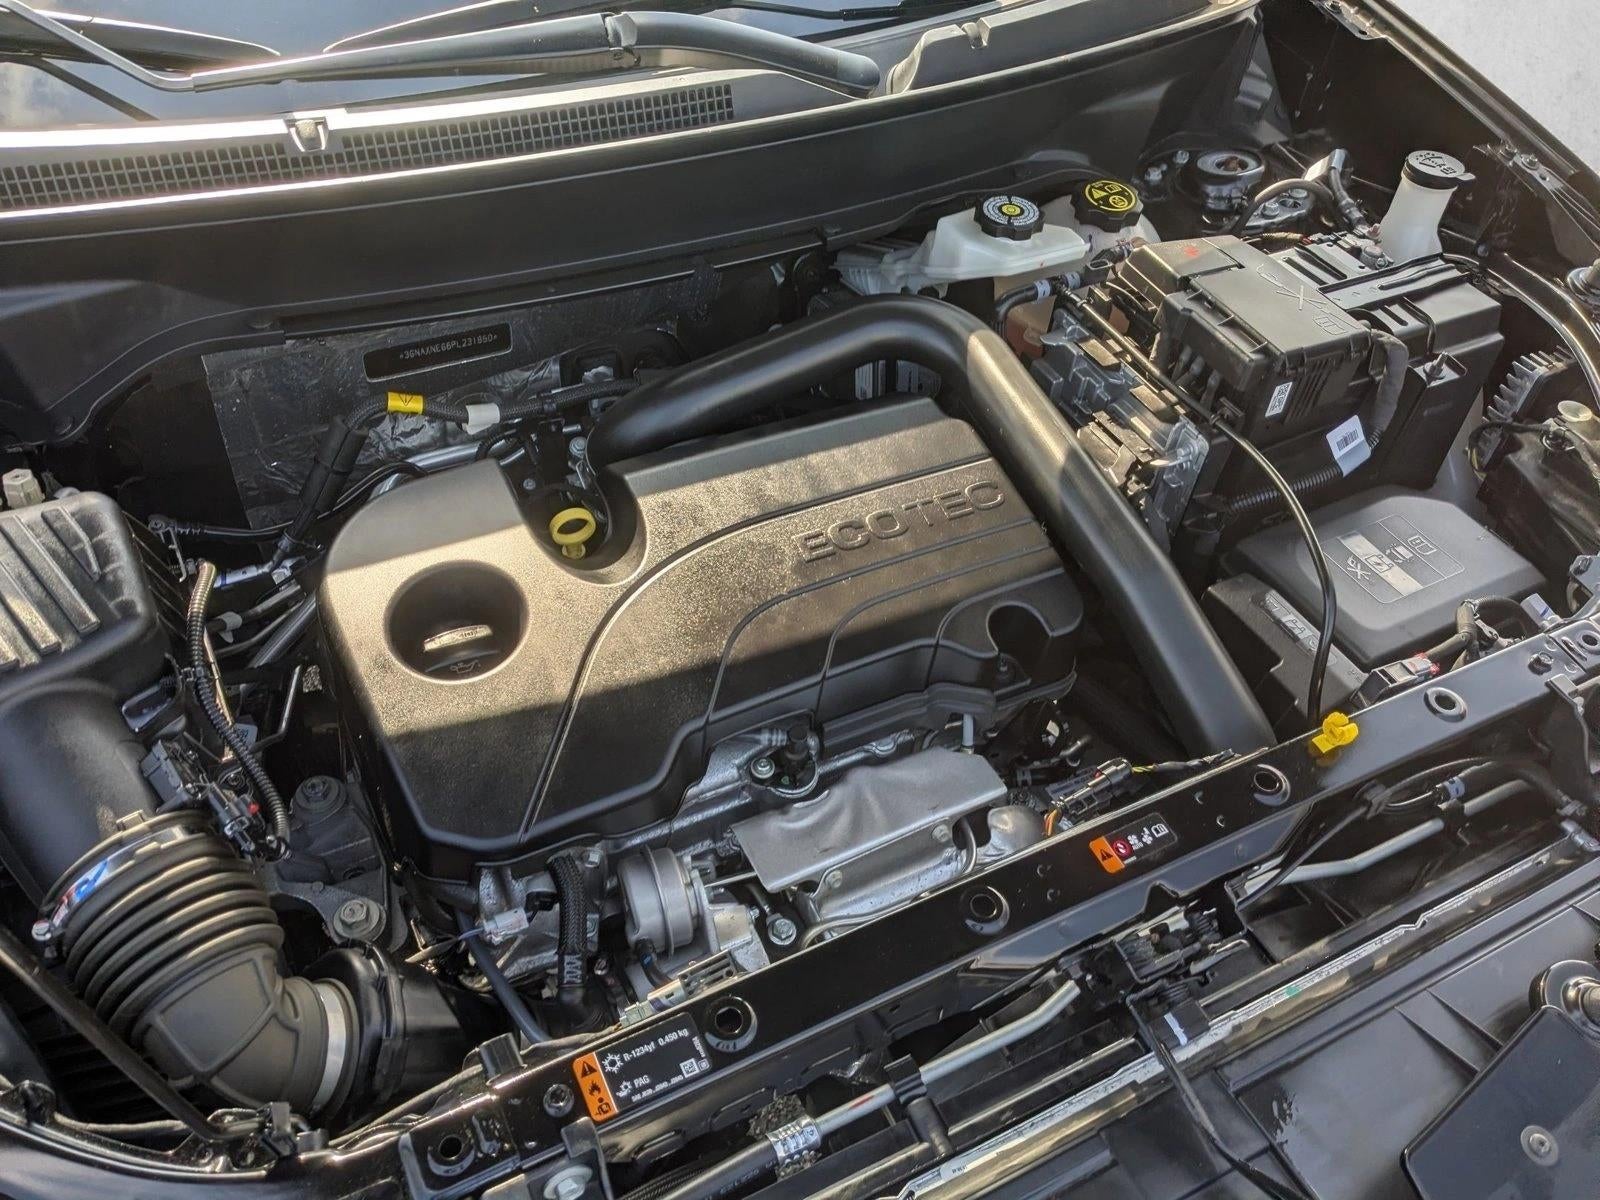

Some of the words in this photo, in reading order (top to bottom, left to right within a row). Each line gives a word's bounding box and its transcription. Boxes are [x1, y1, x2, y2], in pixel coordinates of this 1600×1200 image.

[791, 480, 1005, 563] ECOTEC
[623, 1042, 655, 1061] R-1234yf
[658, 1031, 678, 1046] 0.450
[678, 1028, 689, 1038] kg
[633, 1075, 650, 1088] PAG
